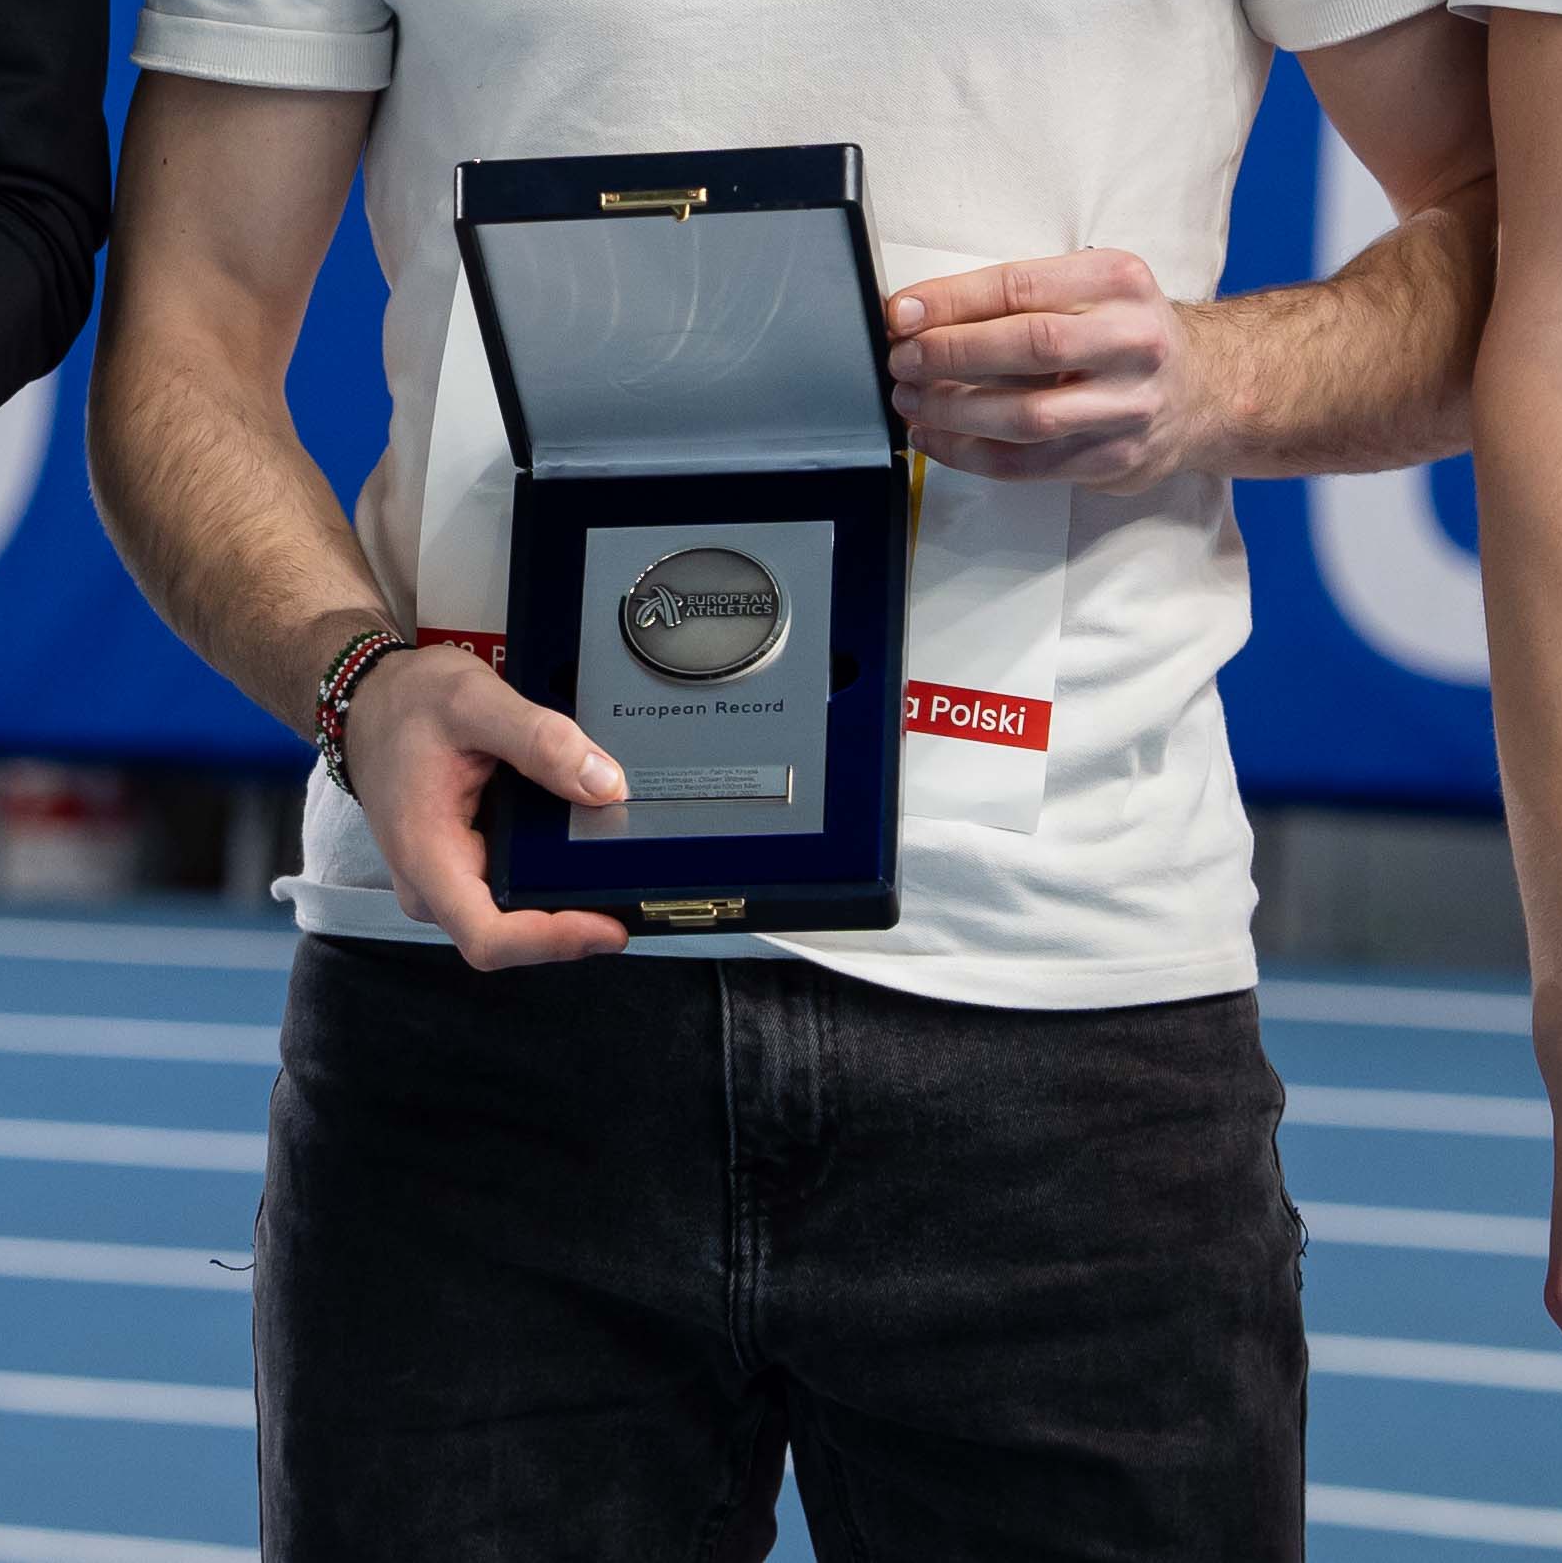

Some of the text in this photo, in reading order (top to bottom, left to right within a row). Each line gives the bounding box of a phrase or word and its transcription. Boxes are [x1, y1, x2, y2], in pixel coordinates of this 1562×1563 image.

[687, 593, 773, 605] EUROPEAN
[686, 604, 773, 617] ATHLETICS
[613, 698, 784, 720] European Record
[930, 695, 1027, 735] Polski
